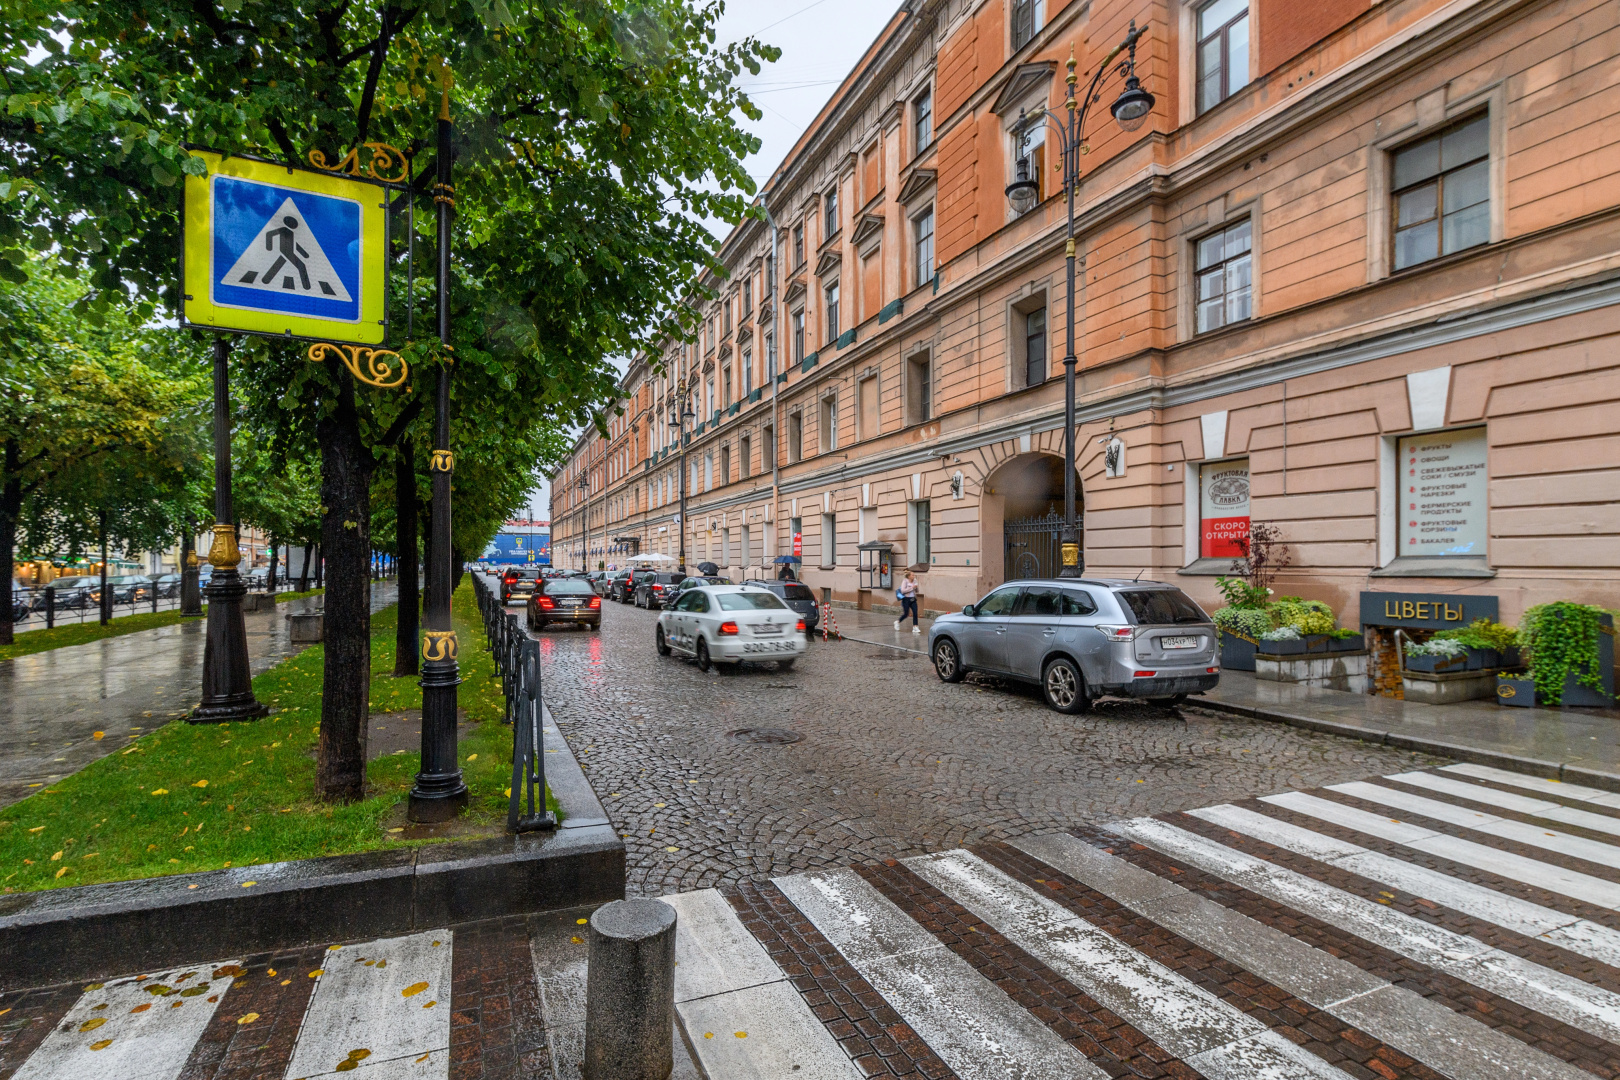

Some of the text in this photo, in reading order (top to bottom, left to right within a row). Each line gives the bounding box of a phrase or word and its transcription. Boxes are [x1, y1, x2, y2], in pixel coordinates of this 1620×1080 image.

[1420, 444, 1452, 452] ФРУКТЫ
[1420, 463, 1486, 475] СВЕЖЕВЫЖАТЫЕ
[1211, 469, 1249, 481] ФРУКТОВАЯ
[1420, 483, 1467, 492] ФРУКТОВЫЕ
[1218, 496, 1241, 504] ЛАВКА
[1420, 501, 1472, 509] ФЕРМЕРСКИЕ
[1214, 522, 1246, 531] СКОРО
[1205, 531, 1249, 540] ОТКРЫТИ
[1385, 600, 1463, 621] ЦВЕТЫ
